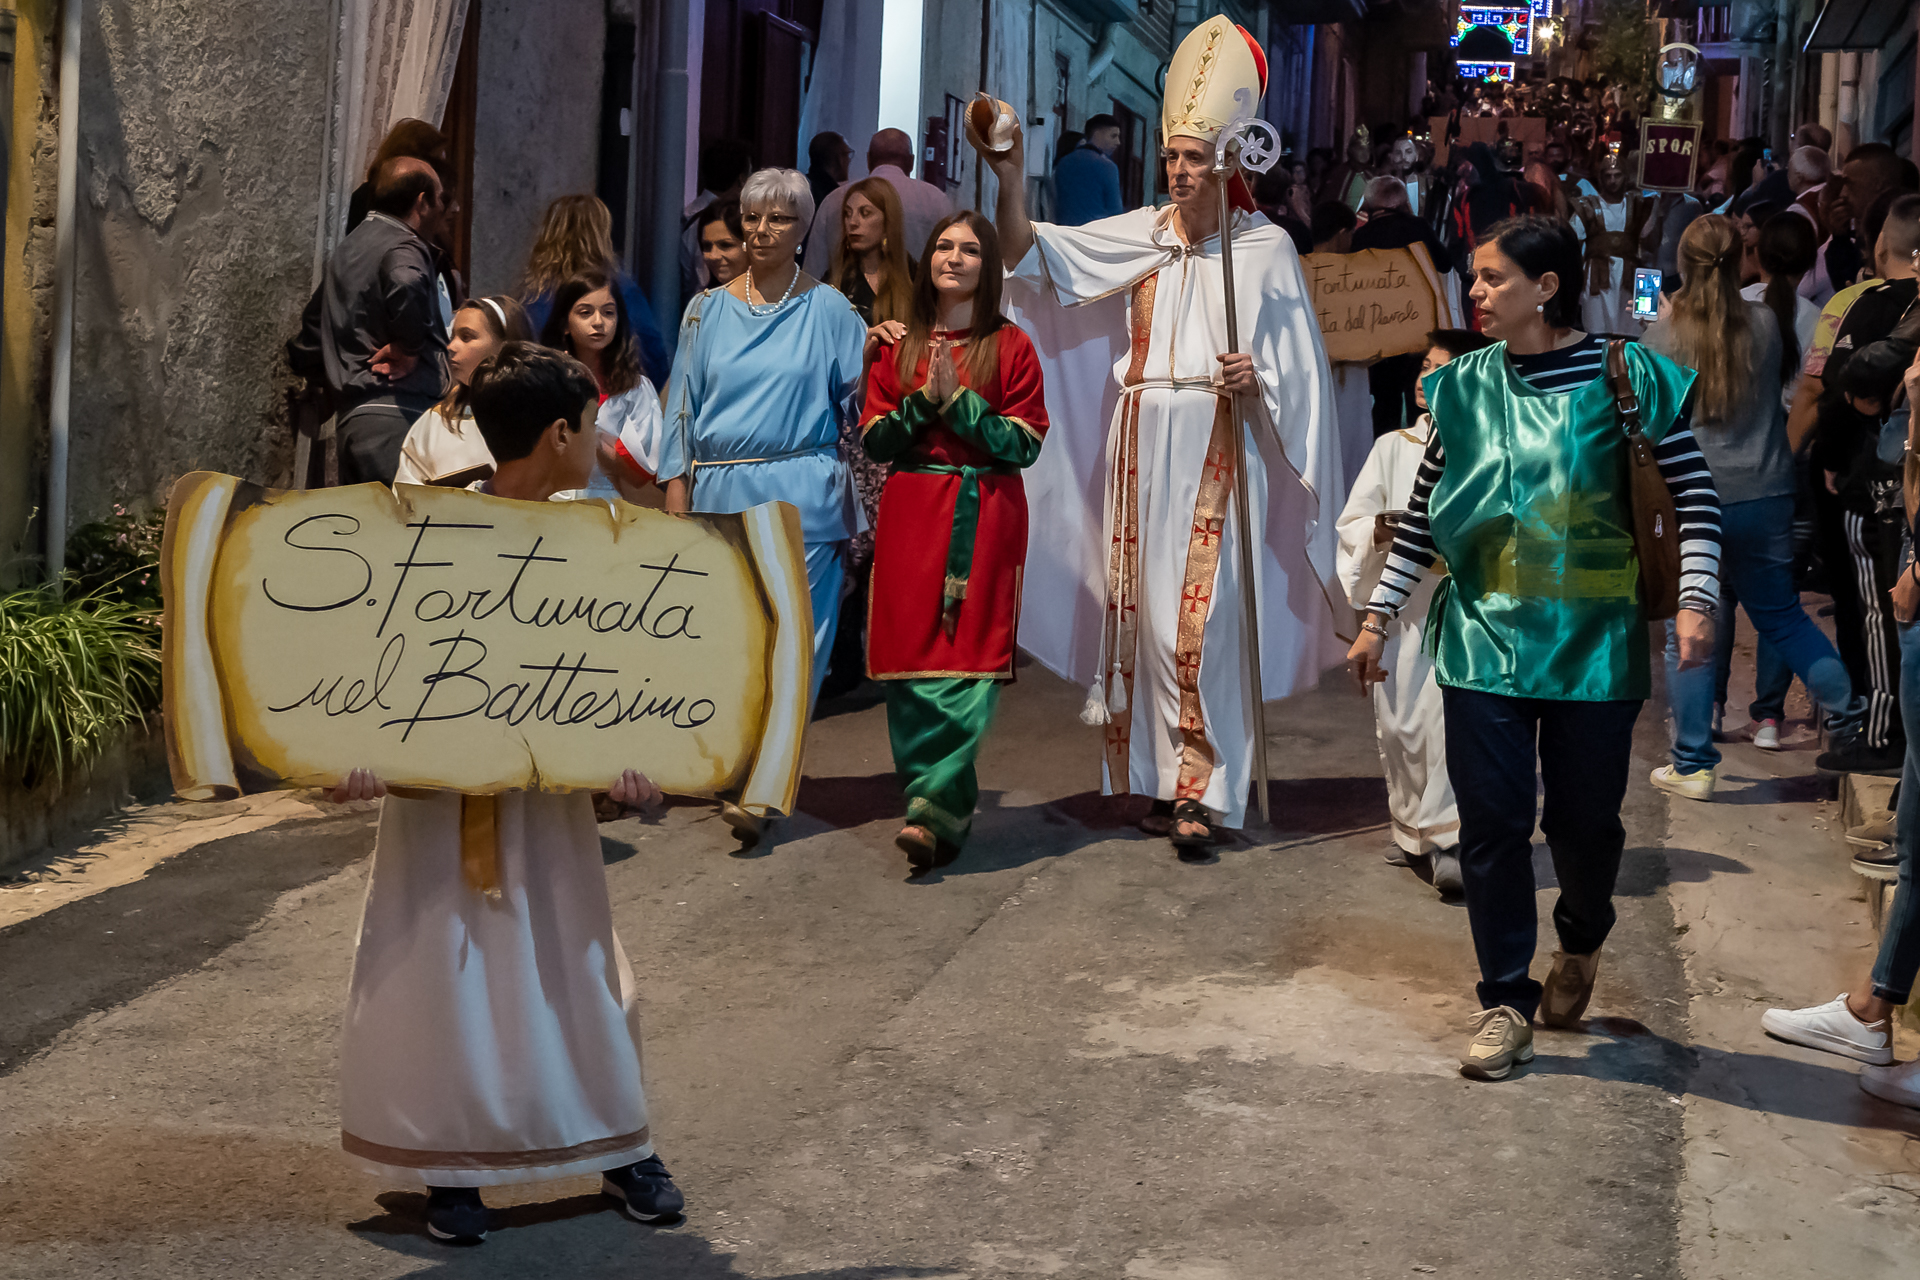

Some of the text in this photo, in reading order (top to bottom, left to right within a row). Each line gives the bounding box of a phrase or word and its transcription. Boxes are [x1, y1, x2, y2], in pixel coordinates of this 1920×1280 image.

[1646, 138, 1693, 156] SPQR
[1312, 262, 1410, 303] Fortunata
[1344, 304, 1367, 332] dal
[375, 514, 709, 640] Fortunata
[267, 628, 716, 743] nel Battesimo
